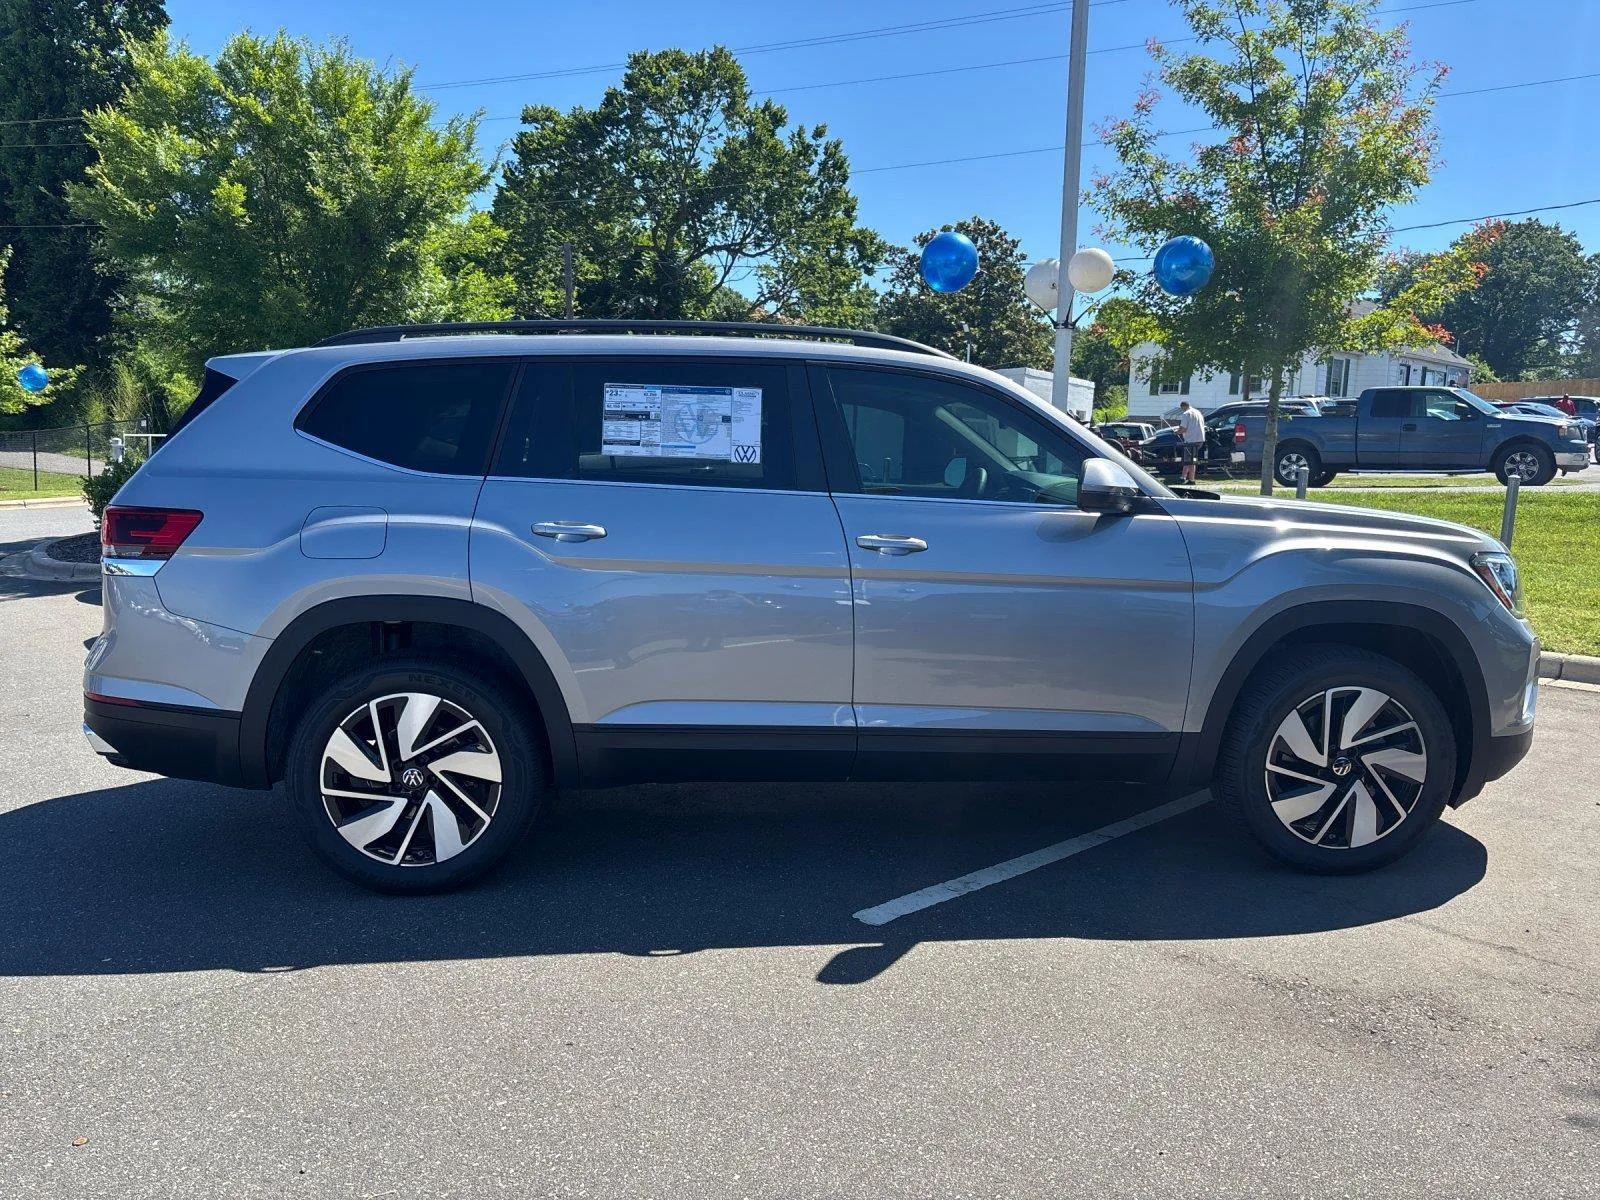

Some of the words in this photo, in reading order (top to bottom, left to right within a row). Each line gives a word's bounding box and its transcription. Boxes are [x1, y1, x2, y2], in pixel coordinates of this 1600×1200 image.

[609, 389, 619, 397] 23
[734, 445, 757, 463] VW
[408, 673, 477, 701] NEXEN
